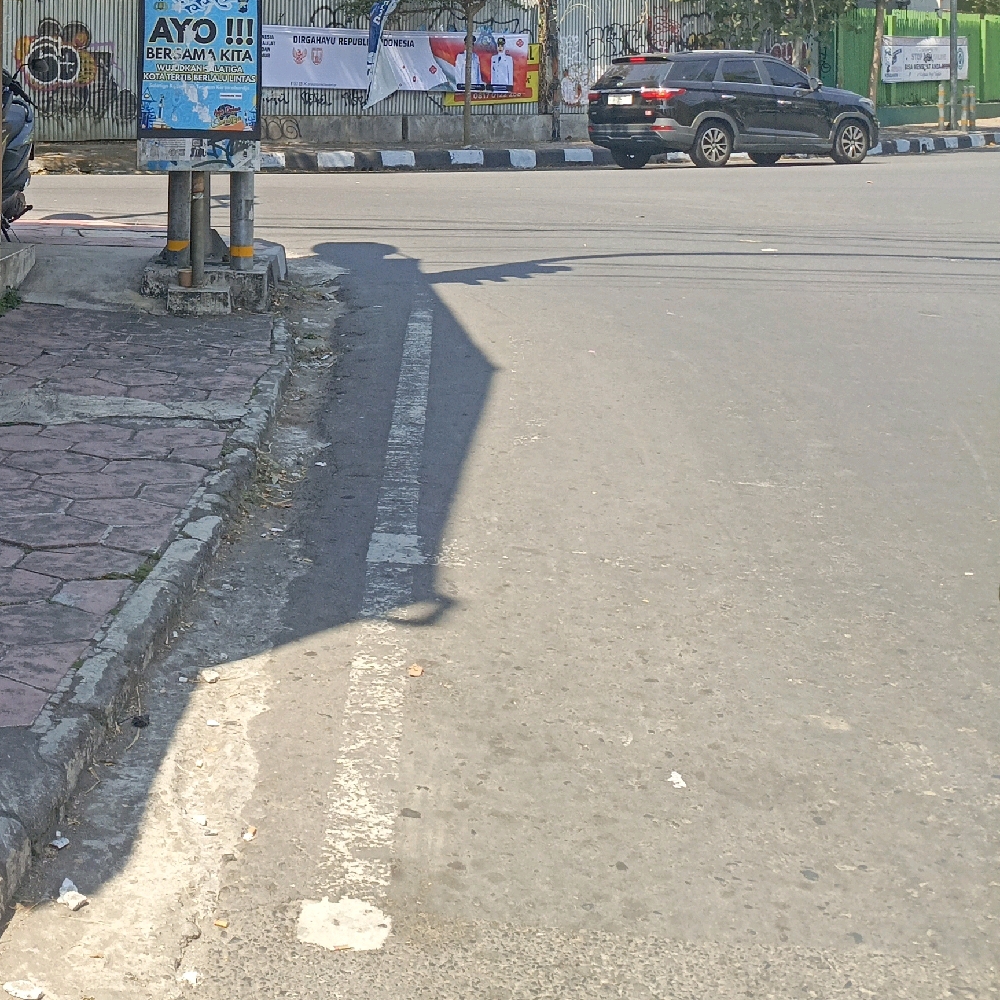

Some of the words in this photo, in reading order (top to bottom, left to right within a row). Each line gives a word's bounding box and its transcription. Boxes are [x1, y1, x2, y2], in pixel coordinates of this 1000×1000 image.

[148, 17, 217, 45] AYO
[292, 35, 336, 46] DIRGAHAYU
[338, 36, 369, 46] REPUBLI
[146, 47, 217, 62] BERSAMA
[220, 49, 253, 62] KITA
[156, 63, 202, 73] WUJUDKAN
[143, 72, 165, 81] KOTA
[166, 73, 192, 81] TERTIB
[193, 73, 228, 82] BERLALU
[229, 75, 257, 83] LINTAS
